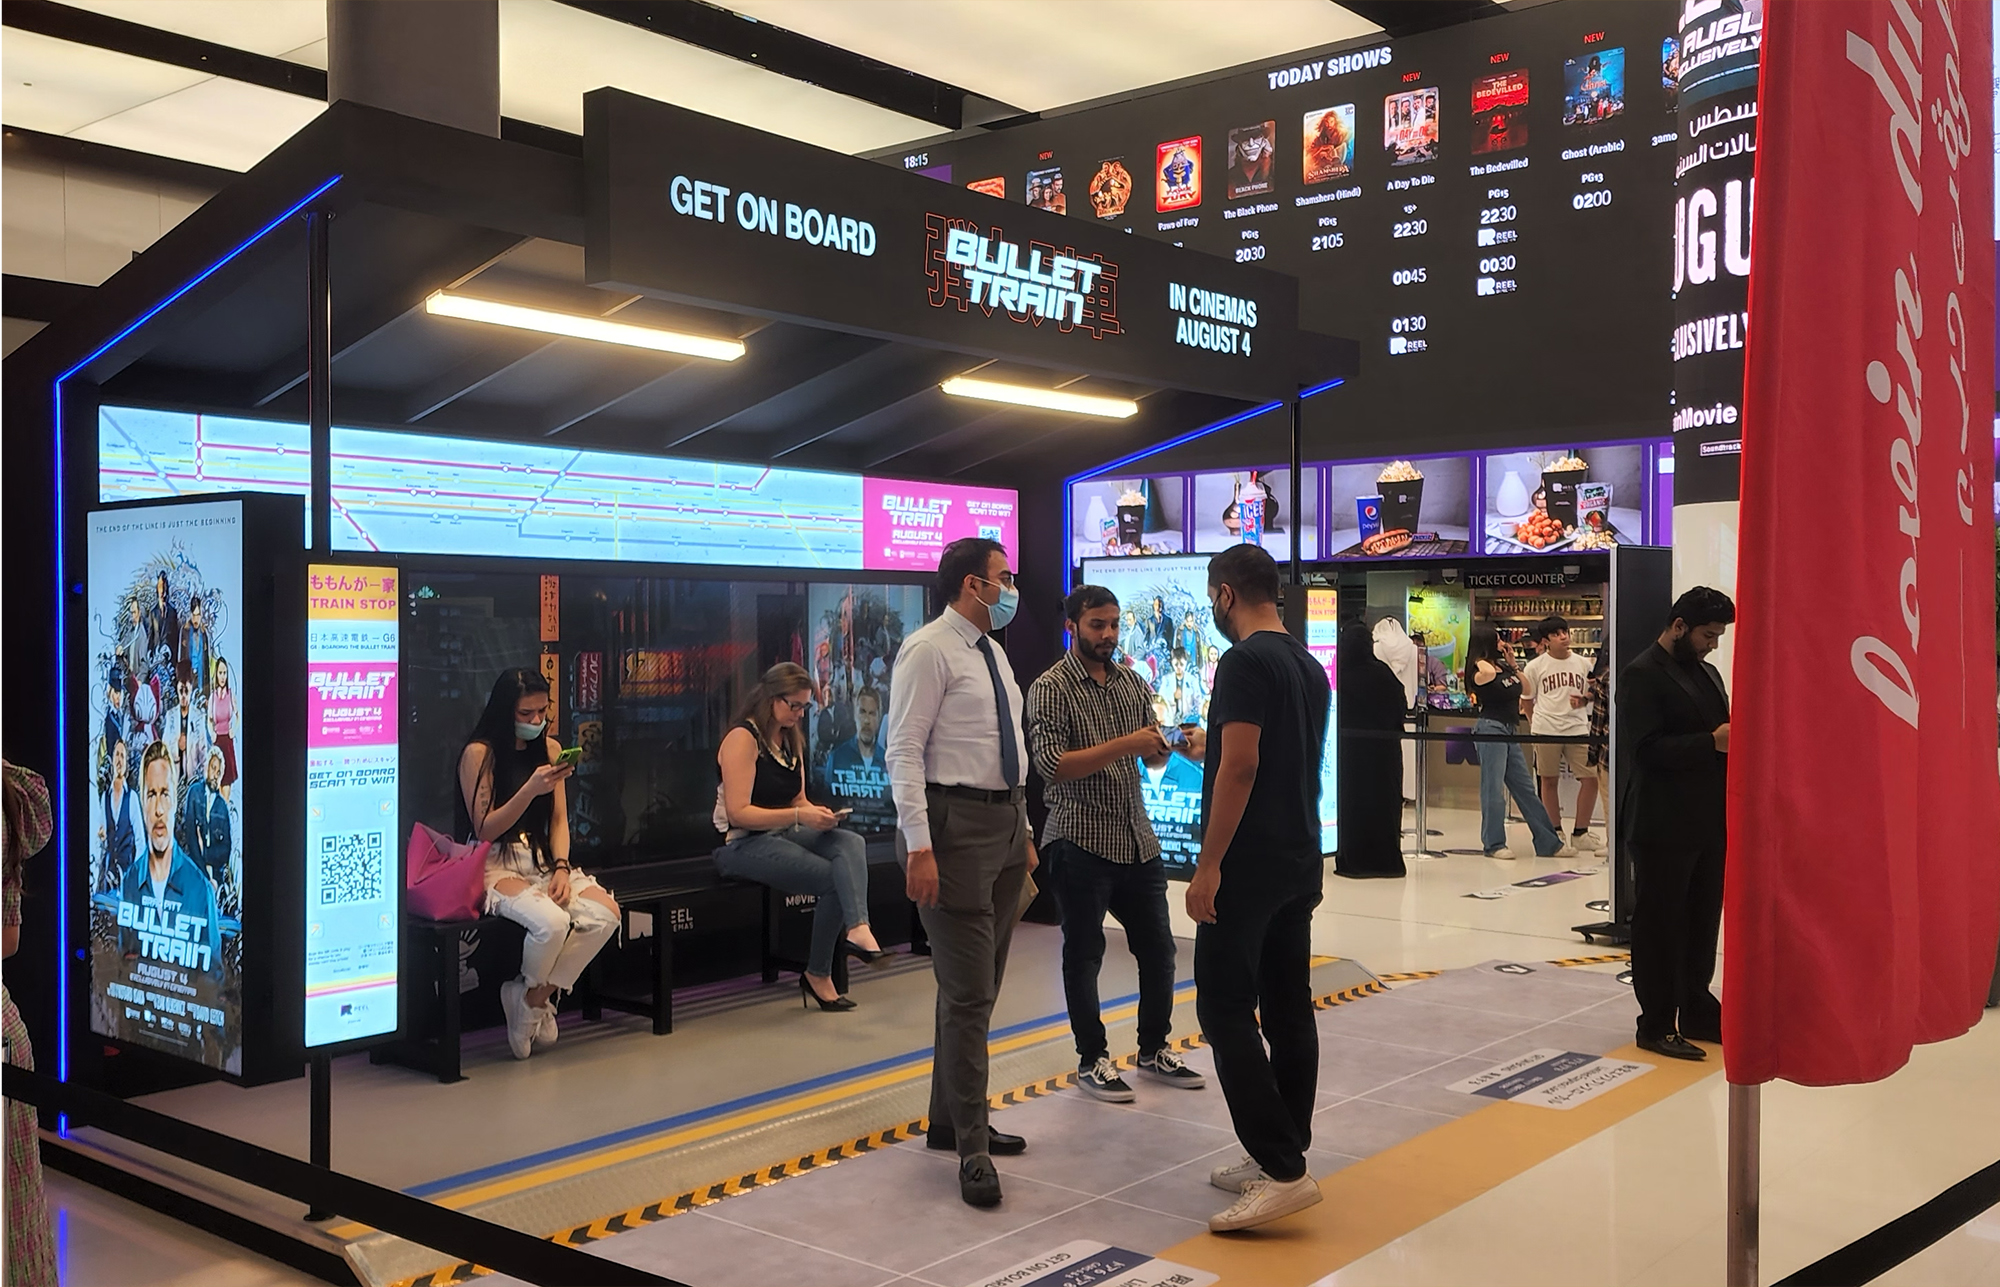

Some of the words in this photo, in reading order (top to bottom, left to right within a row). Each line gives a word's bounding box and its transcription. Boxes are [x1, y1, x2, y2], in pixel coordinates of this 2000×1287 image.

[1583, 31, 1605, 44] NEW
[1490, 52, 1510, 64] NEW
[1267, 62, 1324, 91] TODAY
[1327, 47, 1393, 77] SHOWS
[1402, 72, 1422, 83] NEW
[1492, 80, 1507, 90] THE
[1476, 83, 1523, 98] BEDEVILLED
[1038, 151, 1053, 161] NEW
[1561, 145, 1588, 161] Ghost
[1589, 139, 1625, 157] (Arabic)
[903, 153, 929, 169] 18:15
[1470, 166, 1485, 176] The
[1485, 157, 1529, 174] Bedevilled
[1387, 181, 1394, 191] A
[1394, 179, 1410, 190] Day
[1411, 177, 1420, 187] To
[1421, 175, 1436, 185] Die
[1581, 173, 1604, 184] PG13
[1295, 192, 1336, 207] Shamshera
[1336, 186, 1362, 200] (Hindi)
[1488, 188, 1509, 199] PG15
[1572, 189, 1612, 210] 0200
[670, 175, 731, 223] GET
[737, 192, 778, 235] ON
[785, 203, 877, 257] BOARD
[1223, 209, 1237, 220] The
[1236, 207, 1256, 218] Black
[1256, 203, 1279, 214] Phone
[1480, 205, 1517, 225] 2230
[1158, 221, 1176, 231] Paws
[1176, 219, 1183, 228] of
[1184, 217, 1199, 227] Fury
[1318, 217, 1337, 227] PG15
[1393, 219, 1428, 239] 2230
[1241, 230, 1259, 240] PG15
[1312, 233, 1344, 251] 2105
[1495, 230, 1518, 240] REEL
[946, 228, 1102, 294] BULLET
[1235, 245, 1266, 263] 2030
[1479, 255, 1516, 274] 0030
[1392, 267, 1427, 286] 0045
[1495, 280, 1517, 289] REEL
[963, 268, 1085, 325] TRAIN
[1169, 282, 1186, 312] IN
[1189, 287, 1258, 328] CINEMAS
[1392, 315, 1427, 333] 0130
[1176, 317, 1240, 355] AUGUST
[1242, 331, 1251, 357] 4
[1407, 340, 1428, 349] REEL
[882, 494, 952, 515] BULLET
[966, 500, 981, 508] GET
[1242, 503, 1264, 519] ICEE
[132, 523, 143, 531] THE
[145, 522, 158, 530] LINE
[168, 520, 183, 528] JUST
[186, 519, 198, 527] THE
[201, 517, 236, 526] BEGINNING
[889, 510, 944, 528] TRAIN
[892, 529, 932, 541] AUGUST
[934, 531, 942, 541] 4
[1469, 575, 1507, 585] TICKET
[1509, 574, 1565, 584] COUNTER
[310, 598, 355, 609] TRAIN
[360, 599, 396, 610] STOP
[382, 633, 396, 642] G6
[309, 671, 395, 687] BULLET
[318, 686, 385, 700] TRAIN
[323, 707, 372, 717] AUGUST
[373, 707, 382, 716] 4
[309, 771, 332, 780] GET
[336, 769, 353, 778] ON
[356, 767, 395, 777] BOARD
[310, 779, 345, 789] SCAN
[350, 777, 367, 786] TO
[371, 775, 395, 785] WIN
[1142, 789, 1202, 808] LLET
[1144, 805, 1201, 825] RAIN
[117, 901, 207, 942] BULLET
[138, 931, 212, 972] TRAIN
[137, 963, 178, 982] AUGUST
[180, 973, 188, 985] 4
[1045, 1253, 1071, 1265] GET
[1025, 1263, 1049, 1273] ON
